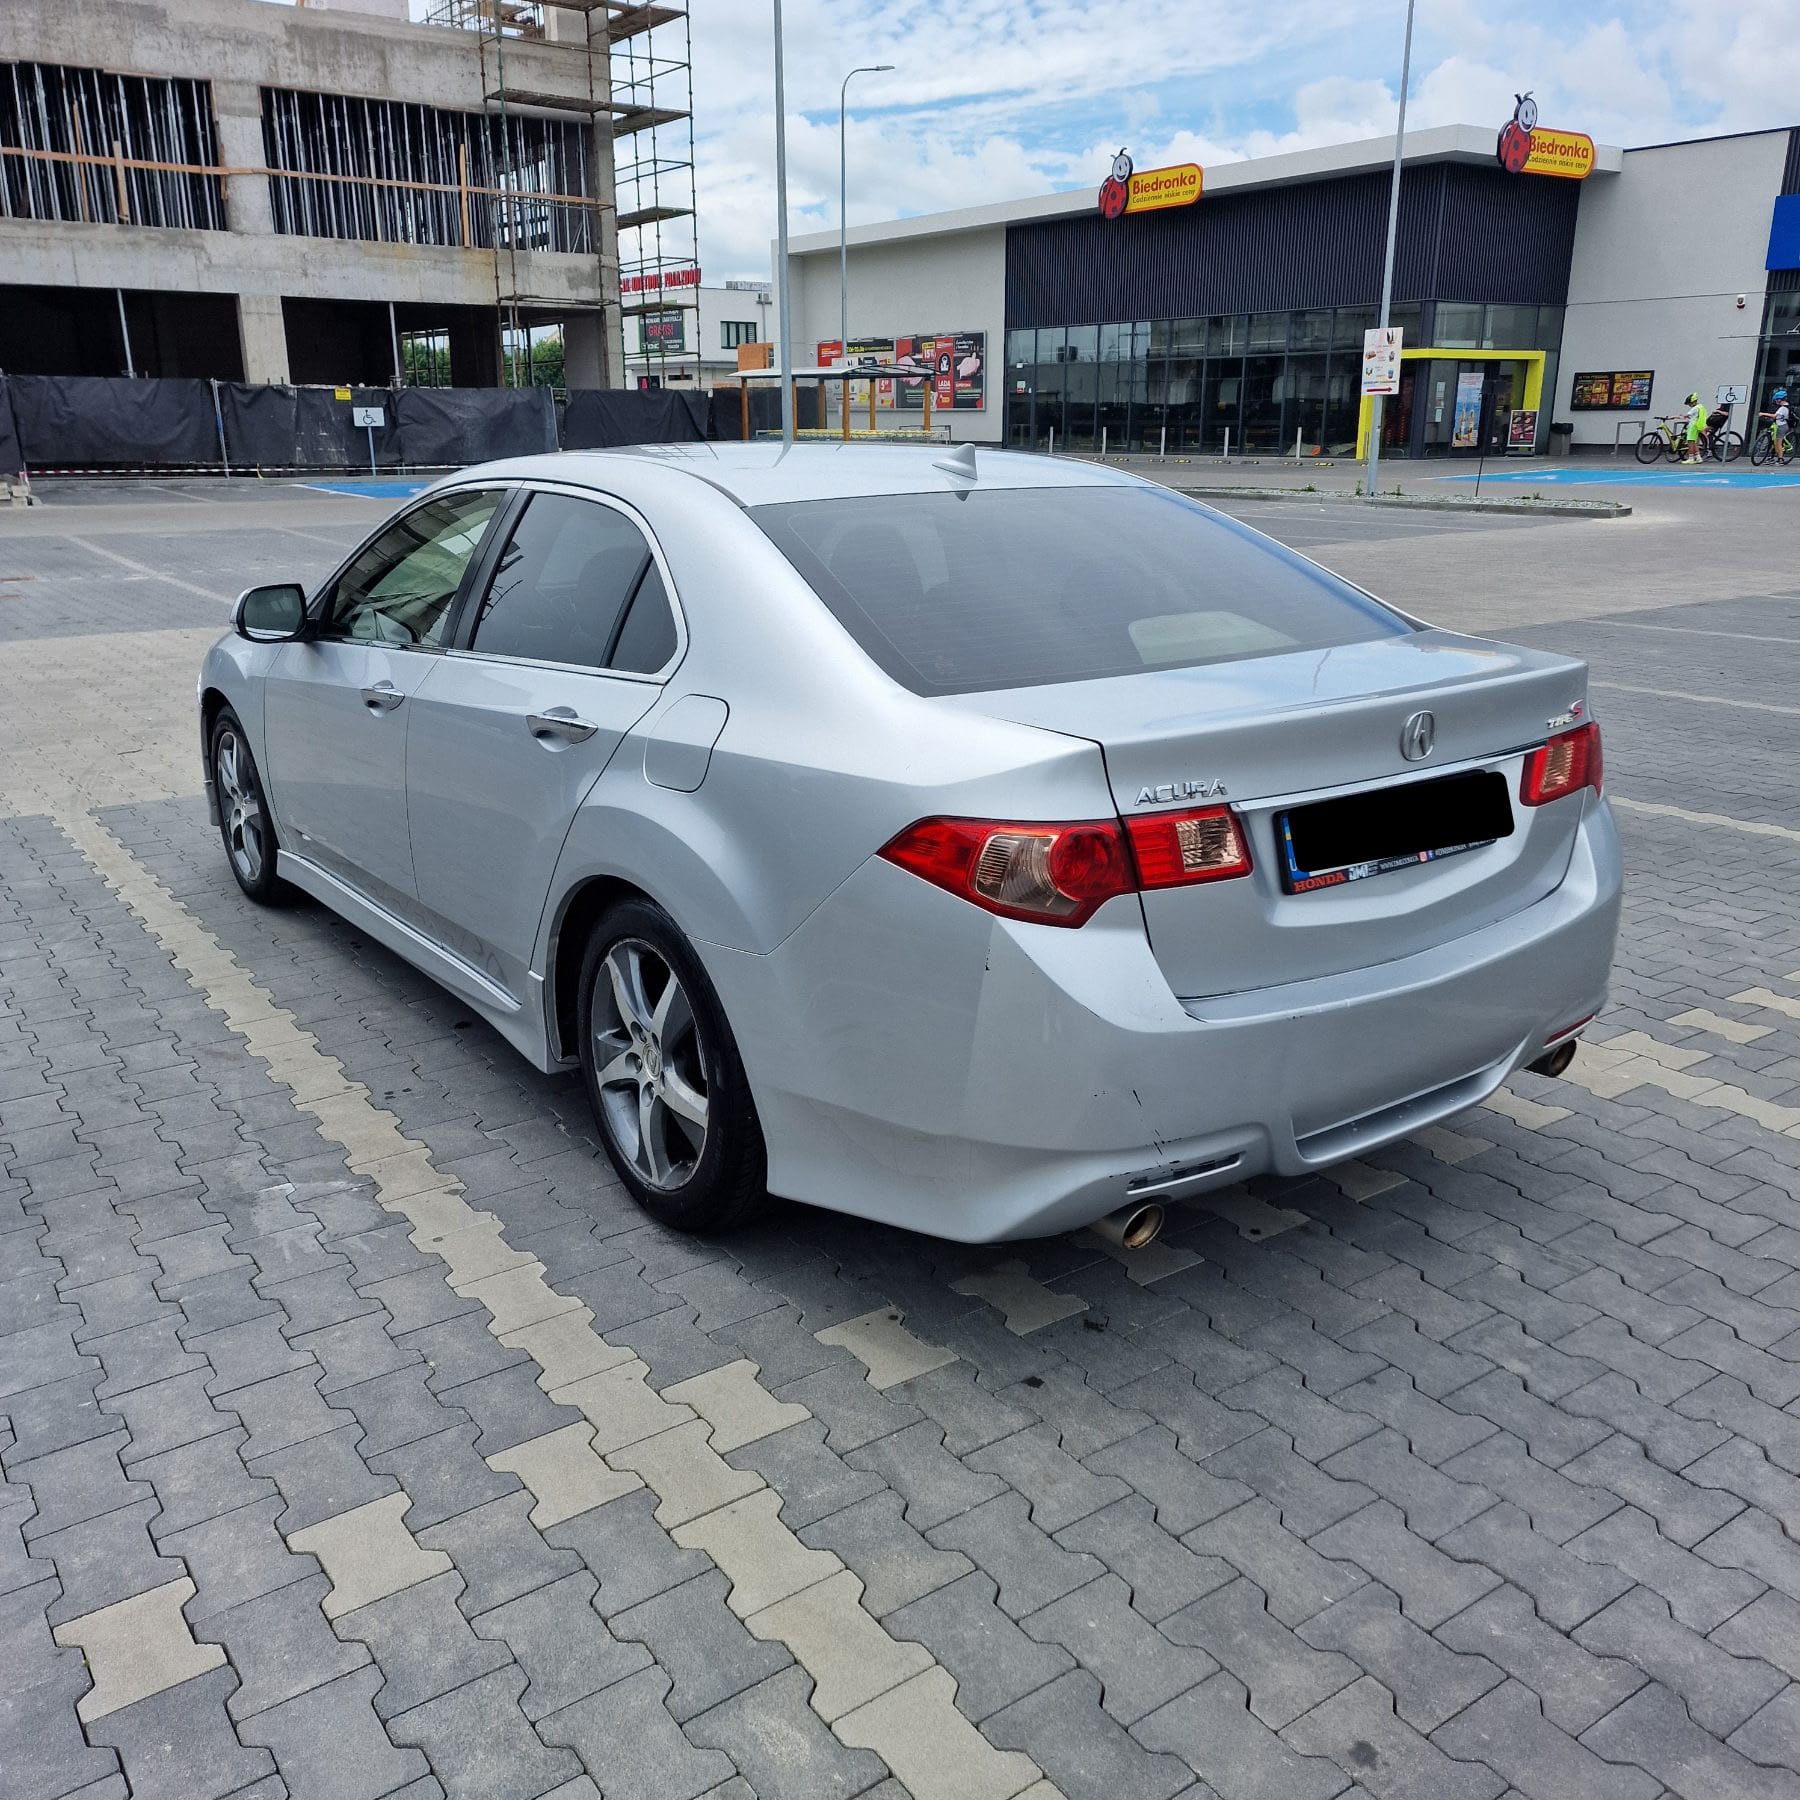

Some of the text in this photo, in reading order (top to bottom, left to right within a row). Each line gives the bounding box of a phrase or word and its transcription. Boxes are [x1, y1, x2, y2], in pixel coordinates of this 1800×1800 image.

[1529, 135, 1588, 158] Biedronka
[1132, 172, 1196, 194] Biedronka
[1570, 699, 1585, 721] S
[1134, 778, 1228, 806] ACURA
[1294, 872, 1345, 892] HONDA
